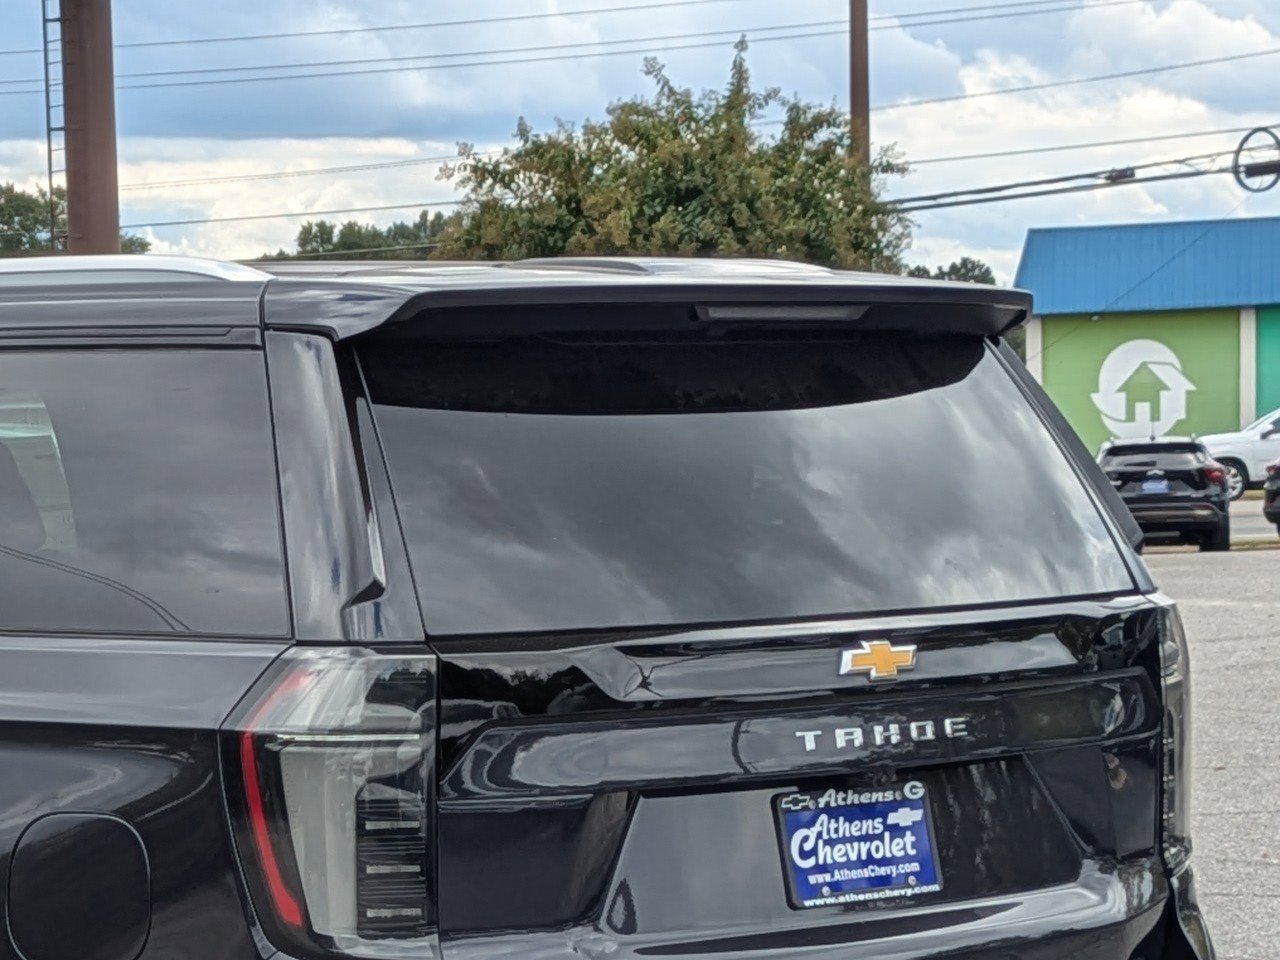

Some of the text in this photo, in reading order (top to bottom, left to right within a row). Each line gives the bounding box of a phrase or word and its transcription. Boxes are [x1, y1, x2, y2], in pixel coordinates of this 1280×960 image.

[795, 717, 968, 751] TAHOE
[818, 788, 894, 808] Athens
[791, 830, 916, 868] Chevrolet
[803, 813, 883, 851] Athens
[807, 862, 920, 885] www.AthensChevy.com
